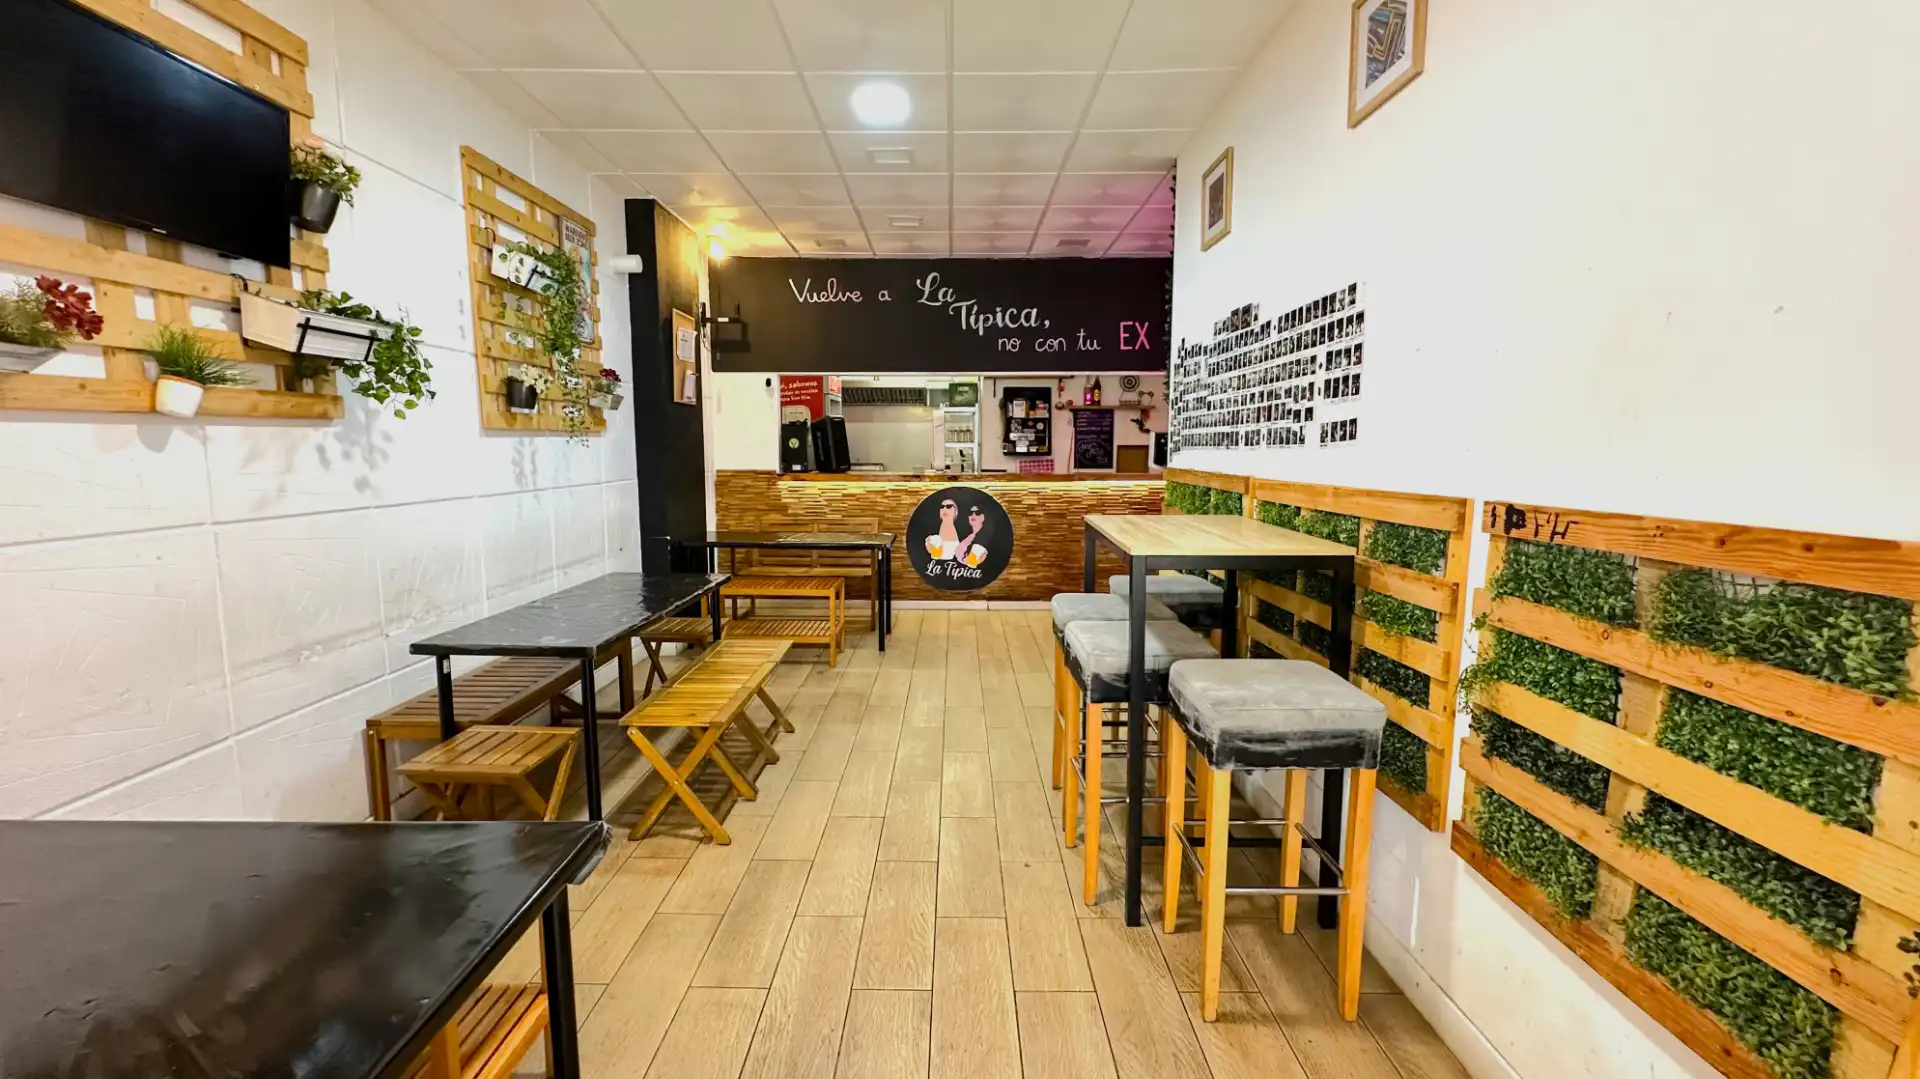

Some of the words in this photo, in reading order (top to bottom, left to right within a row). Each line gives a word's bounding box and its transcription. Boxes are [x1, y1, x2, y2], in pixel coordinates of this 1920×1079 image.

[788, 278, 863, 303] Vuelve
[878, 289, 892, 302] a
[916, 272, 956, 306] La
[949, 298, 1050, 336] Típica,
[998, 337, 1021, 352] no
[1035, 337, 1066, 352] con
[1076, 328, 1101, 352] tu
[1120, 321, 1150, 350] EX
[926, 559, 942, 576] La
[944, 561, 982, 580] Típica
